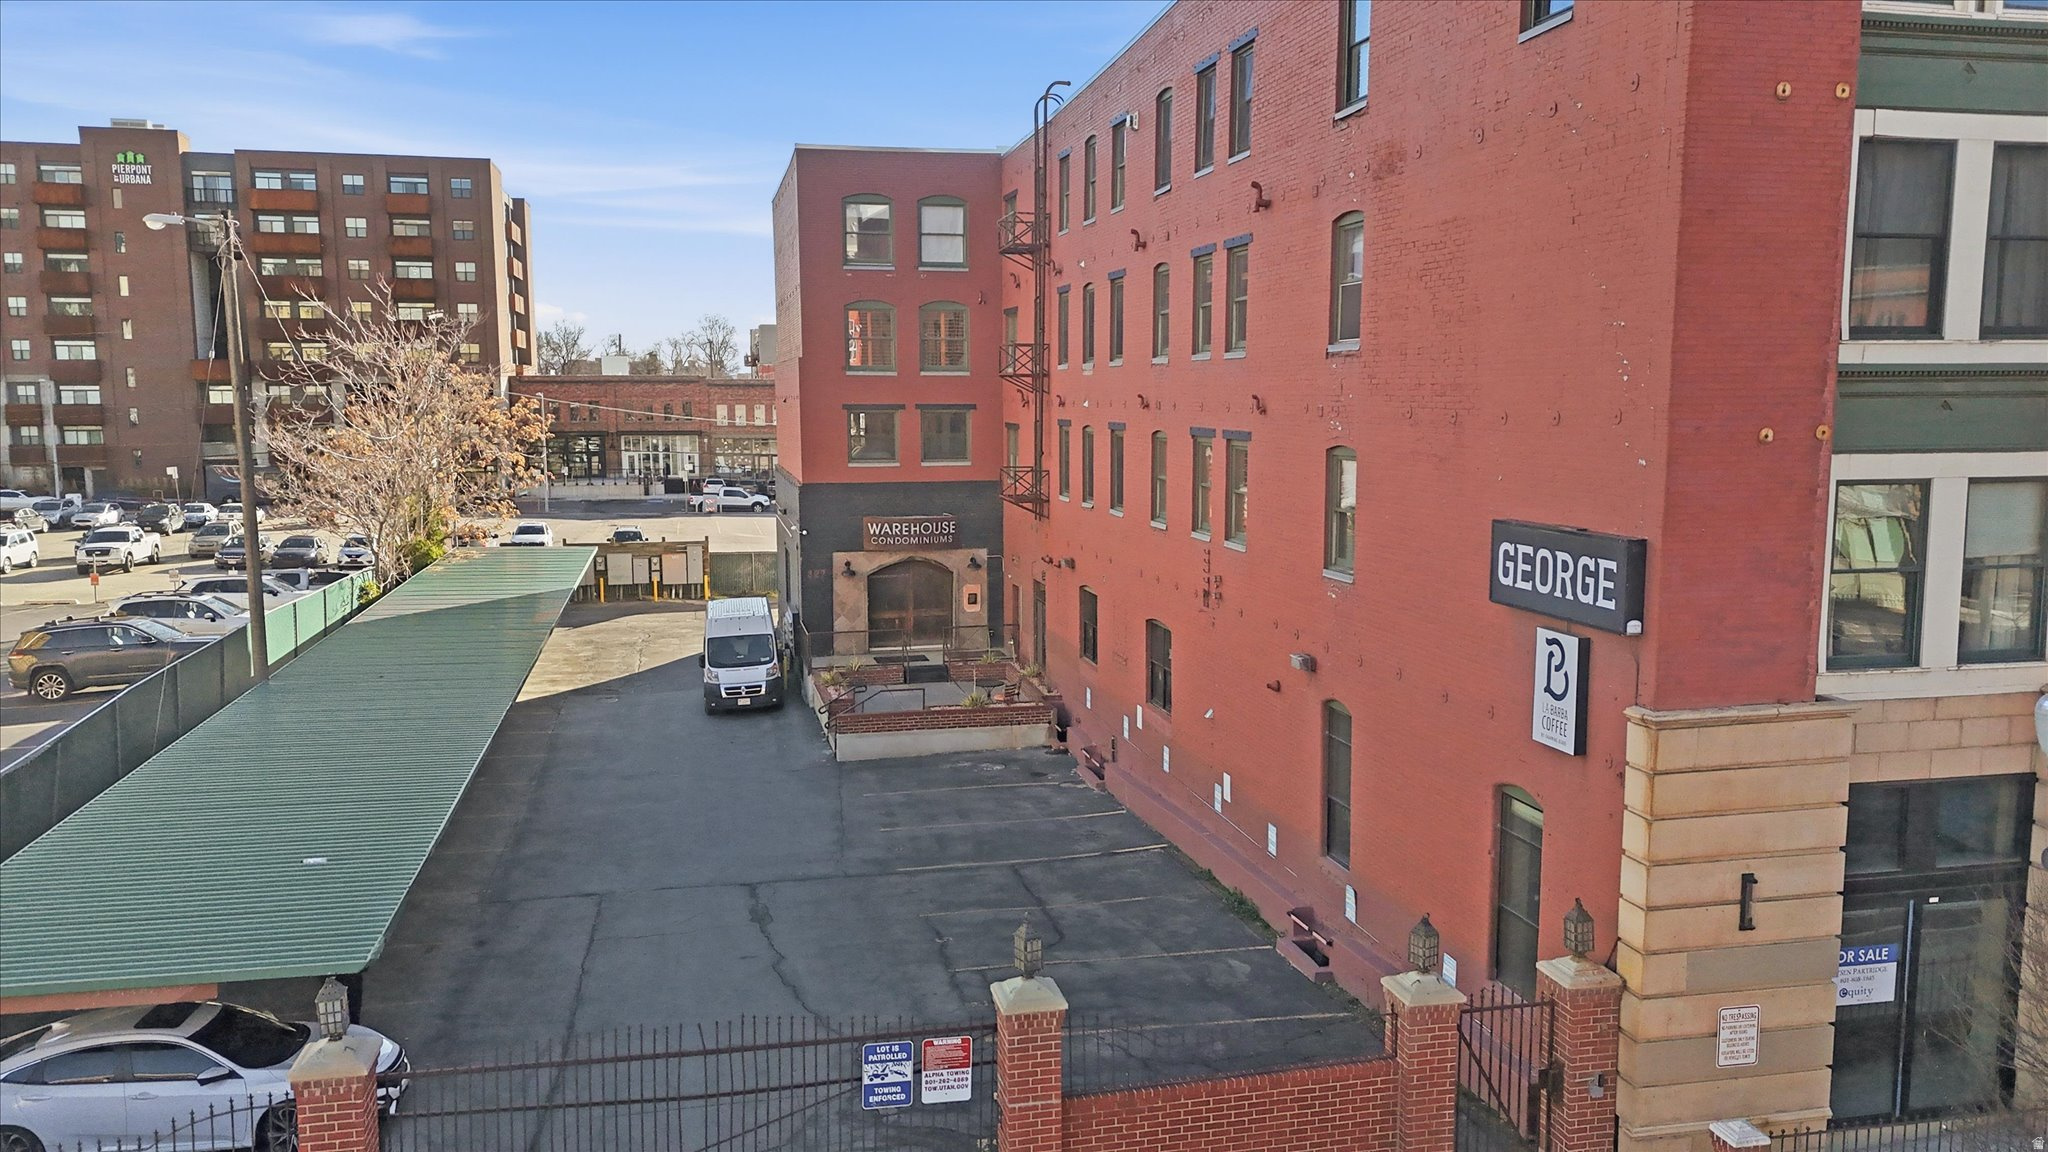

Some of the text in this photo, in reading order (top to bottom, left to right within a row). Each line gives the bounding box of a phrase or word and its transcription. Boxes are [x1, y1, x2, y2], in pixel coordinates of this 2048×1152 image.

[111, 164, 152, 175] PIERPONT
[119, 174, 152, 184] URBANA
[868, 521, 956, 535] WAREHOUSE
[871, 535, 953, 545] CONDOMINIUMS
[1498, 541, 1617, 610] GEORGE
[1541, 702, 1568, 720] LA BARBA
[1541, 715, 1568, 737] COFFEE
[1840, 947, 1889, 963] OR SALE
[1839, 986, 1874, 998] equity
[1729, 1012, 1757, 1020] TRESPASSING
[869, 1052, 907, 1061] PATROLLED
[874, 1086, 901, 1094] TOWING
[869, 1094, 906, 1102] ENFORCED
